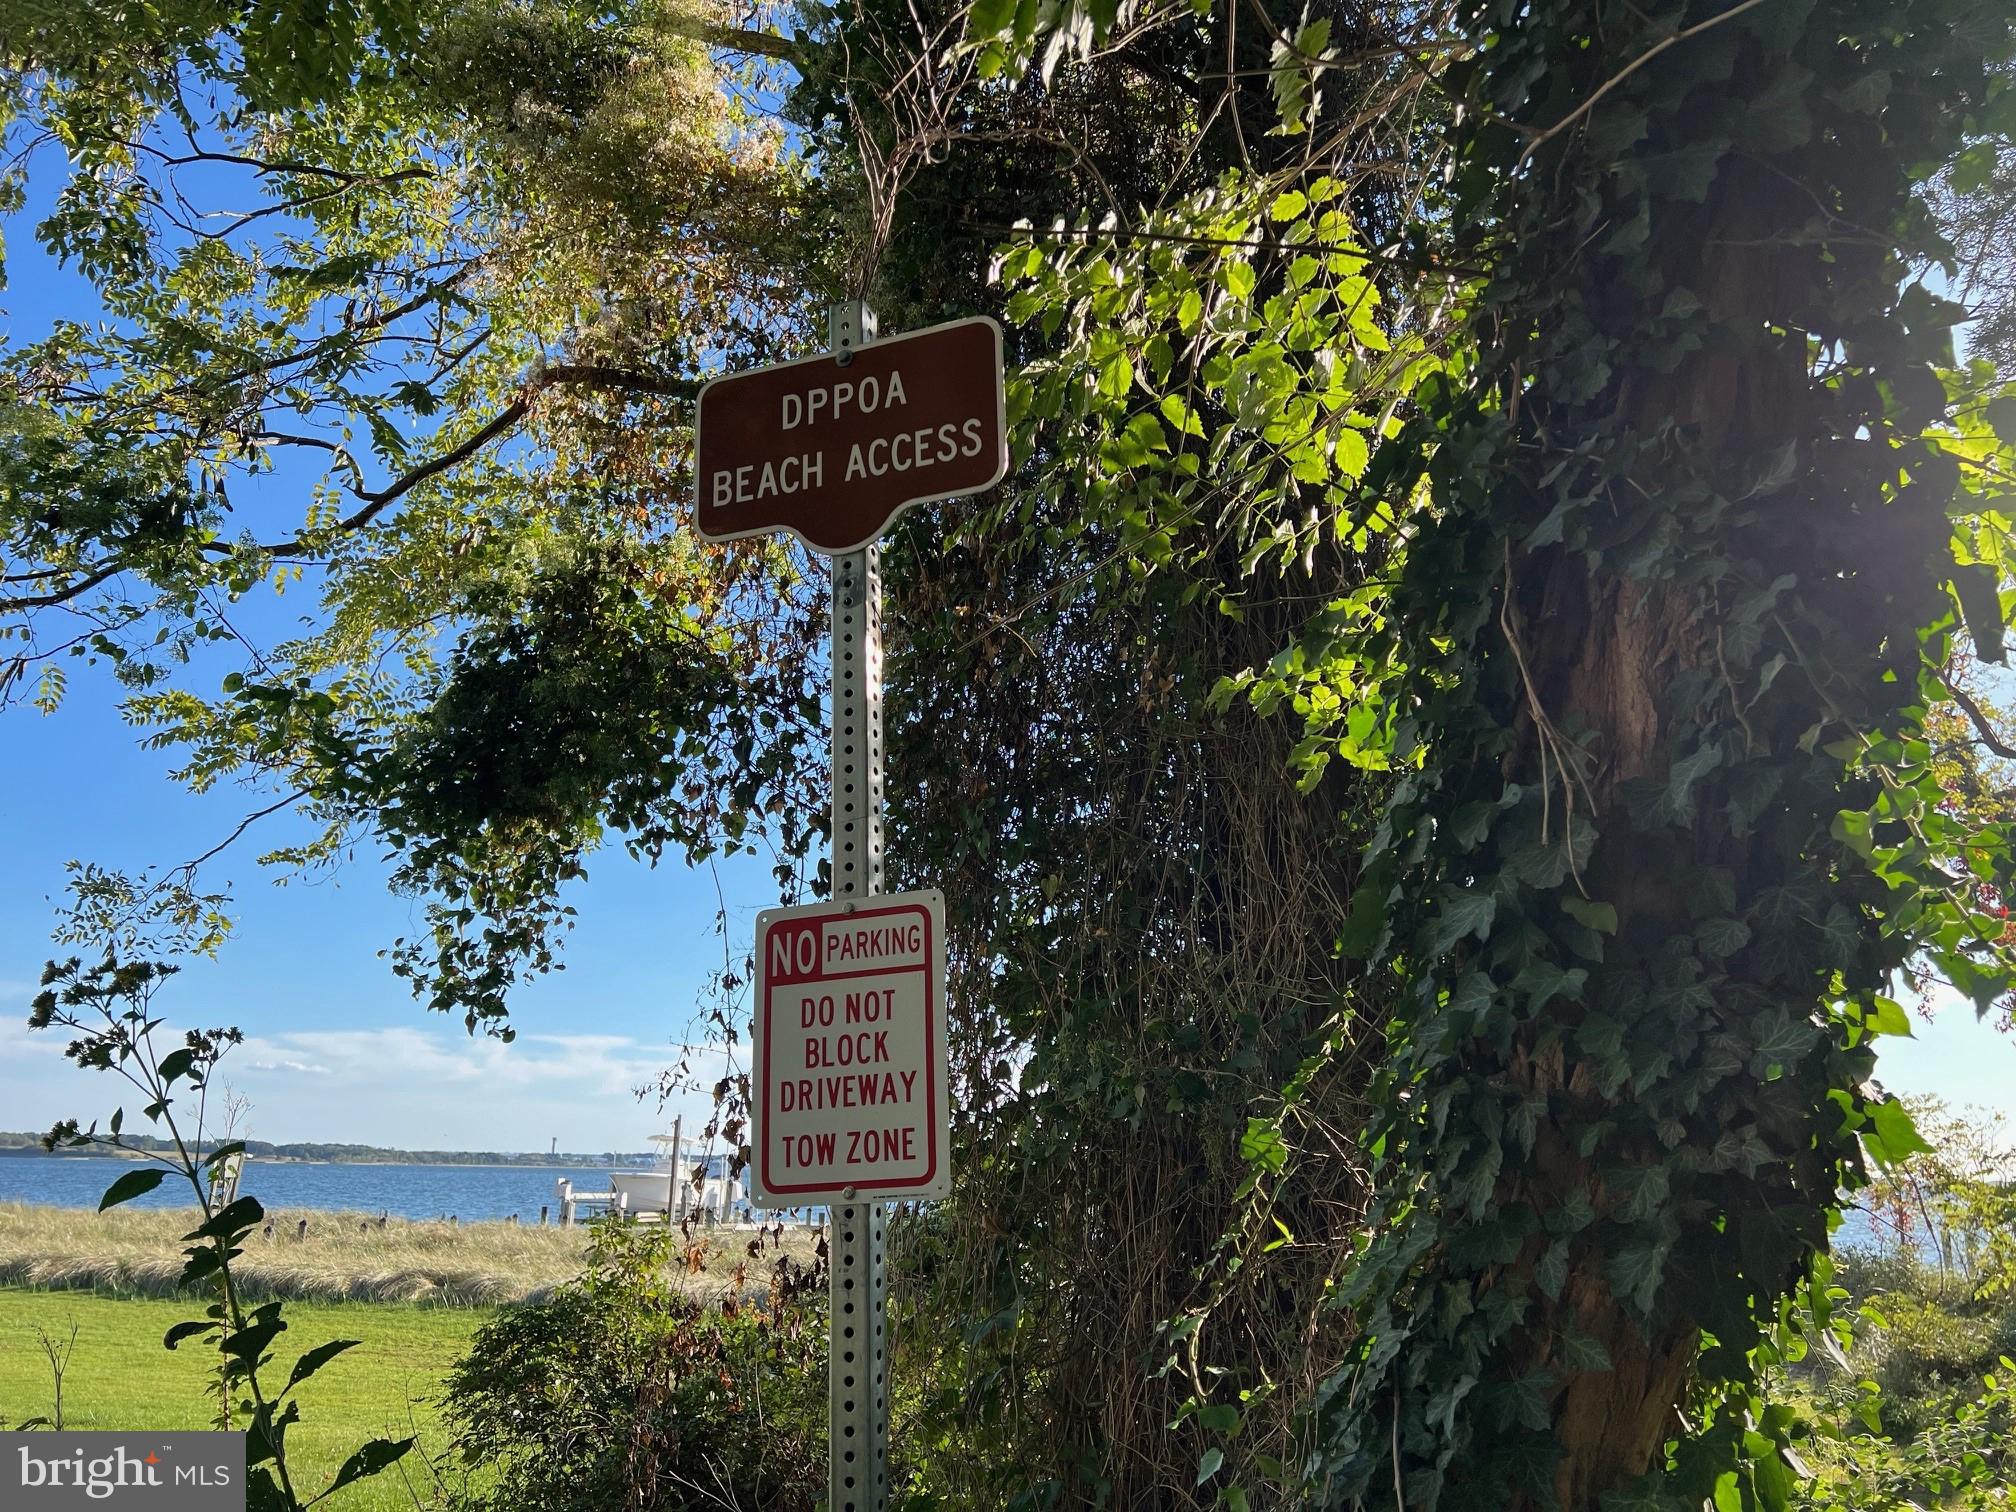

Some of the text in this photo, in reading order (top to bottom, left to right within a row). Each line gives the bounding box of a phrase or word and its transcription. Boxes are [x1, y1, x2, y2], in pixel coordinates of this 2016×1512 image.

[782, 370, 906, 429] DPPOA
[713, 418, 983, 507] BEACH ACCESS
[771, 924, 921, 977] NO PARKING
[801, 989, 896, 1028] DO NOT
[805, 1031, 889, 1068] BLOCK
[780, 1071, 917, 1112] DRIVEWAY
[782, 1127, 916, 1168] TOW ZONE
